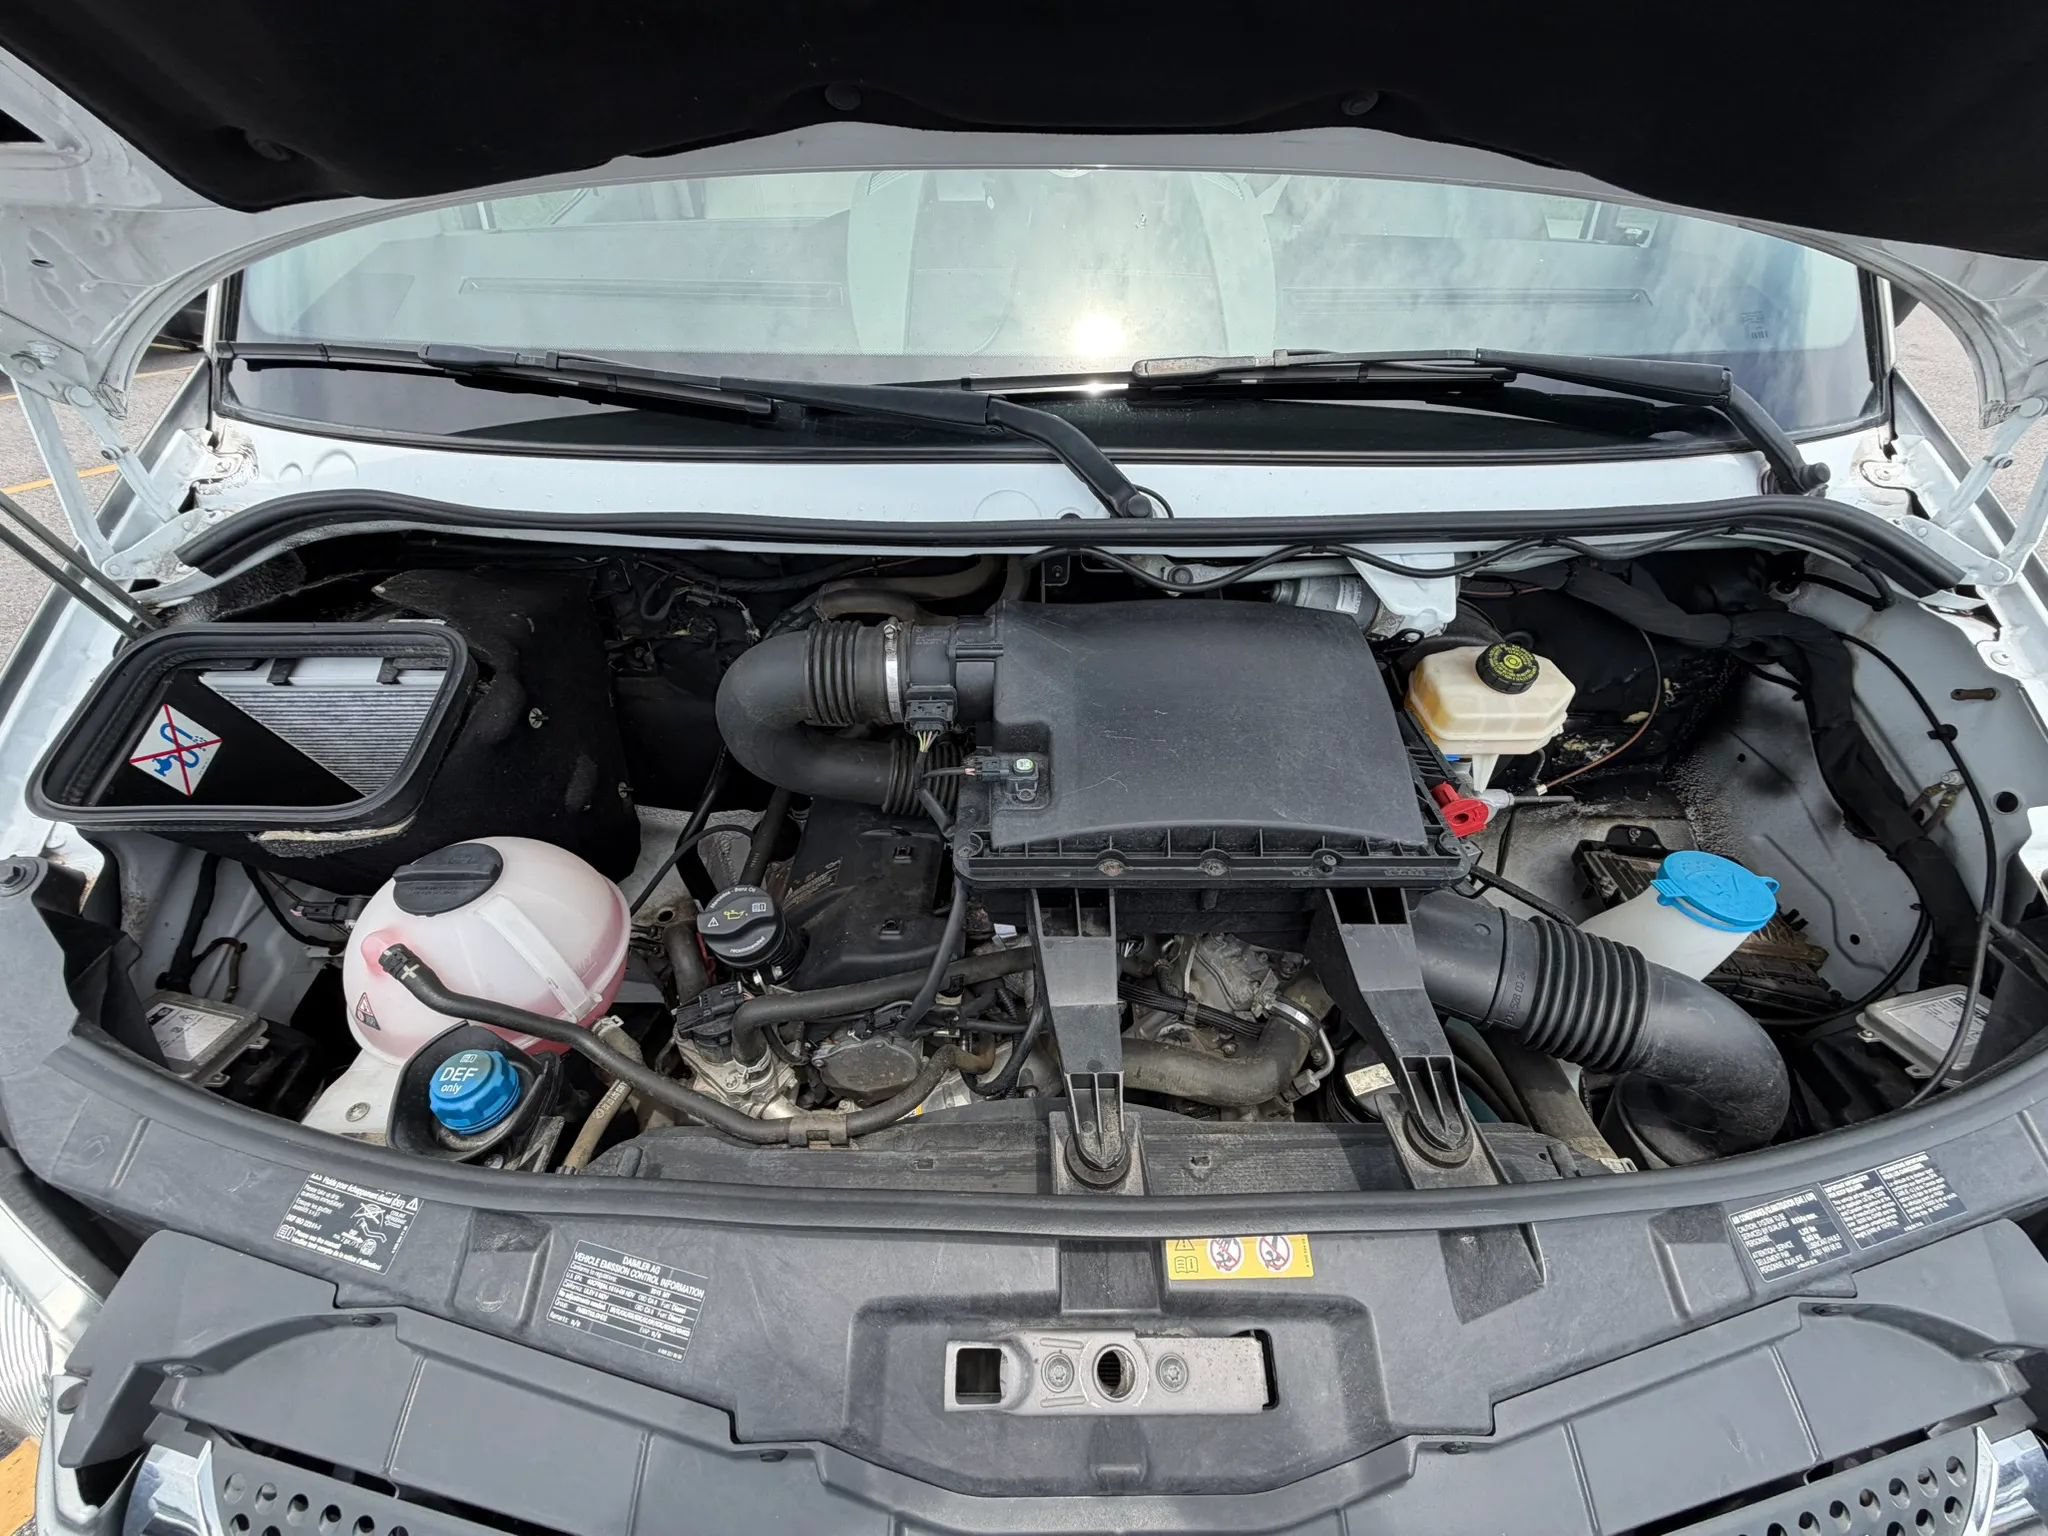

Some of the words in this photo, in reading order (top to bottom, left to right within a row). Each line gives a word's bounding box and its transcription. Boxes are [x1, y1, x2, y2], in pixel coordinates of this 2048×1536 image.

[440, 1067, 479, 1081] DEF
[441, 1083, 462, 1094] only
[621, 1255, 652, 1272] DAIMLER
[650, 1264, 661, 1275] AG
[572, 1251, 600, 1266] VEHICLE
[599, 1259, 630, 1275] EMISSION
[629, 1268, 660, 1285] CONTROL
[659, 1278, 704, 1298] INFORMATION
